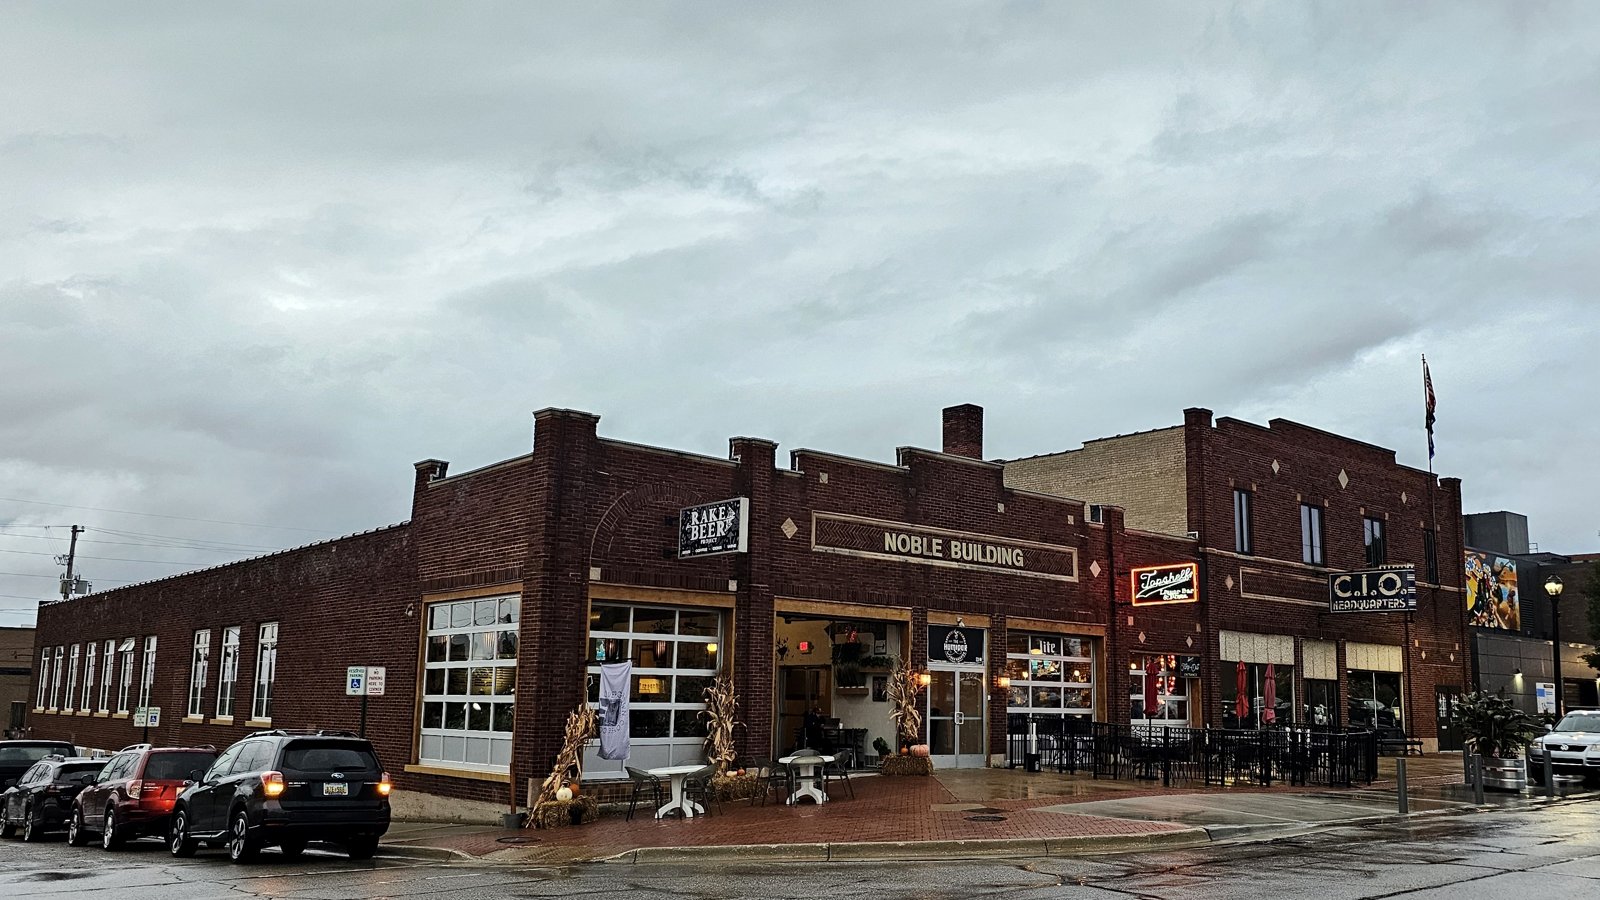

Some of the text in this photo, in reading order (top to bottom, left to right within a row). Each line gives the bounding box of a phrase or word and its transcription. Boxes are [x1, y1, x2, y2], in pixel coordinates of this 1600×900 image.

[691, 506, 726, 526] RAKE
[690, 521, 726, 541] BEER
[884, 532, 1024, 567] NOBLE BUILDING
[1140, 567, 1194, 590] Topshelf
[1334, 572, 1408, 598] C.I.O.
[1333, 598, 1406, 611] HEADQUARTERS
